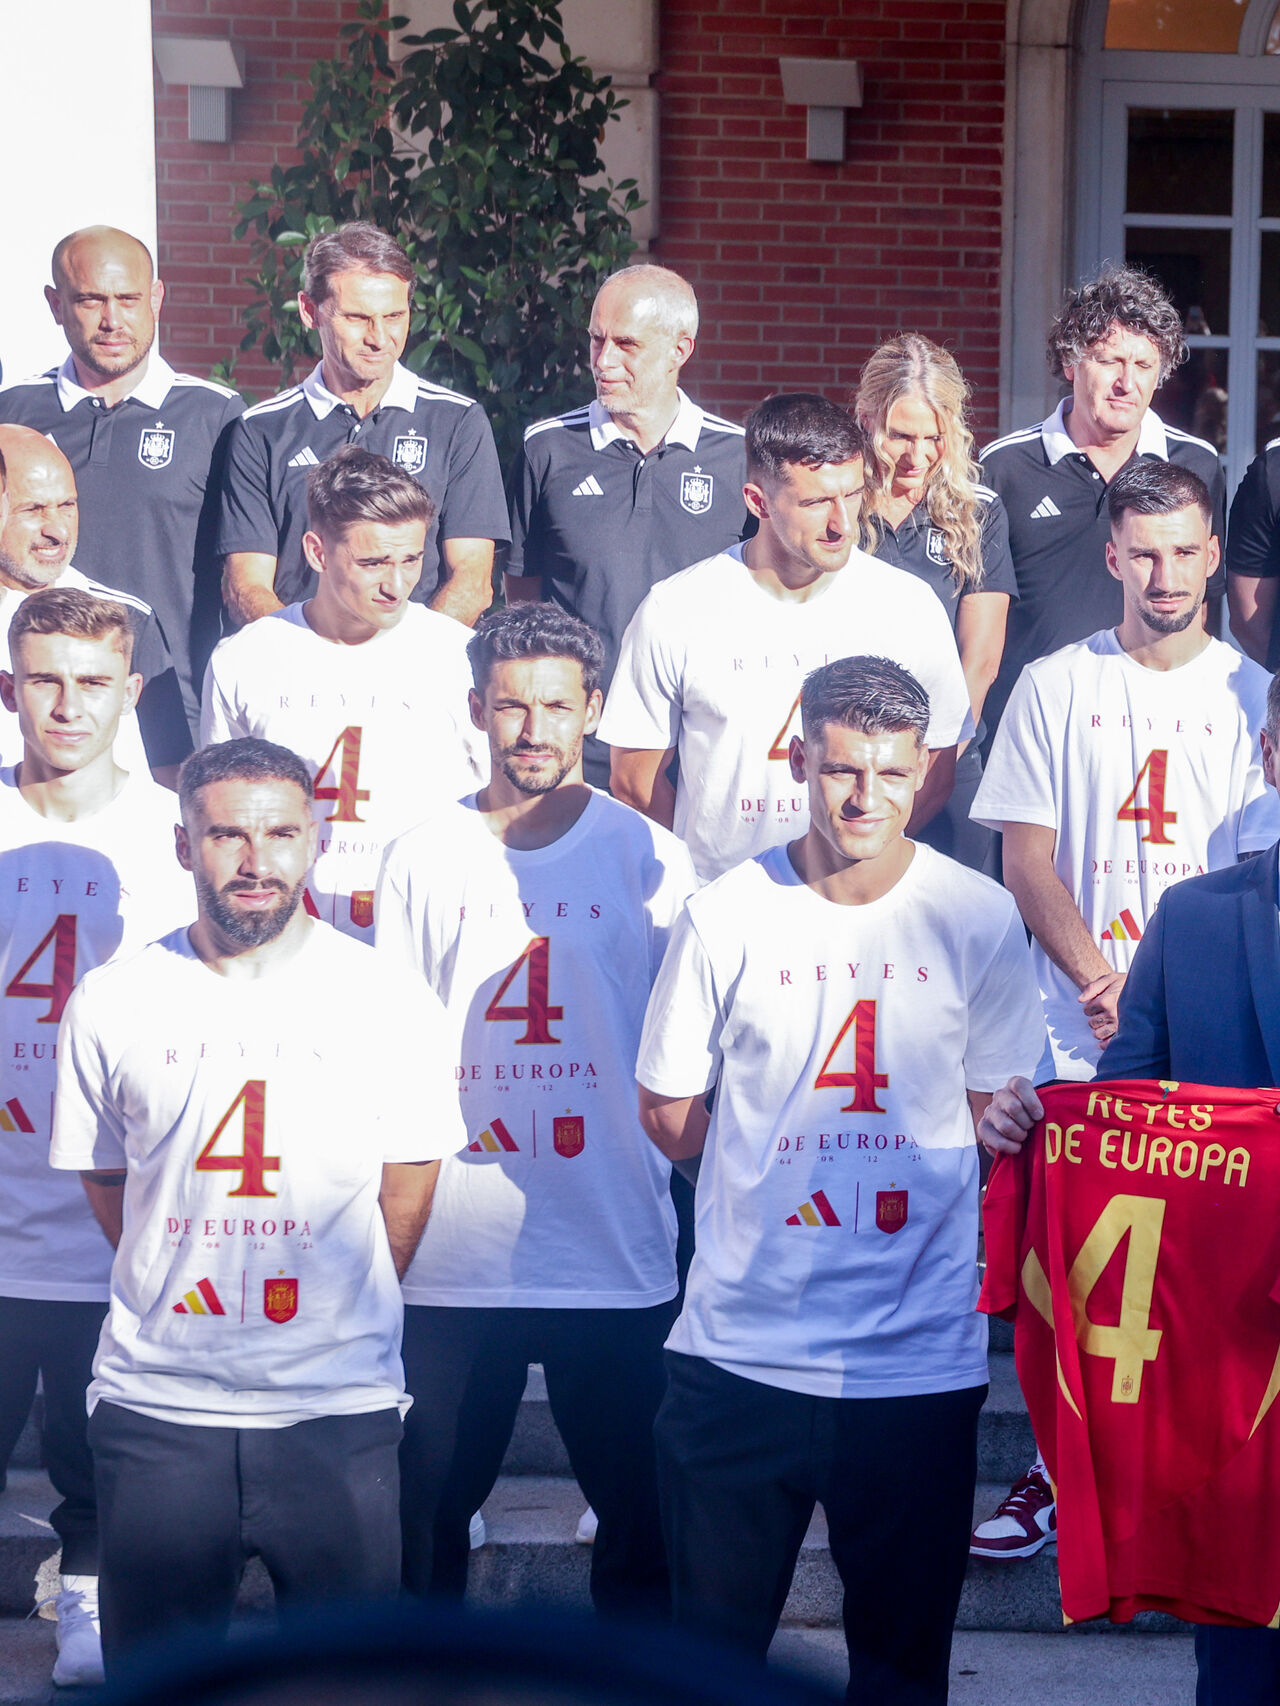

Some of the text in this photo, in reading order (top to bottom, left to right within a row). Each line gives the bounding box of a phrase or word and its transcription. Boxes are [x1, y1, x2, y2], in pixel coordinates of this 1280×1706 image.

[1091, 714, 1214, 737] REYES
[313, 725, 371, 823] 4
[741, 798, 766, 812] DE
[1117, 748, 1178, 845] 4
[1125, 859, 1206, 876] EUROPA
[459, 902, 602, 920] REYES
[5, 913, 78, 1023] 4
[780, 962, 929, 985] REYES
[485, 936, 564, 1045] 4
[455, 1062, 598, 1081] DE EUROPA
[814, 999, 889, 1114] 4
[1086, 1090, 1214, 1131] REYES
[194, 1079, 282, 1199] 4
[777, 1133, 919, 1152] DE EUROPA
[1045, 1122, 1252, 1188] DE EUROPA
[167, 1217, 312, 1237] DE EUROPA
[1066, 1193, 1167, 1404] 4
